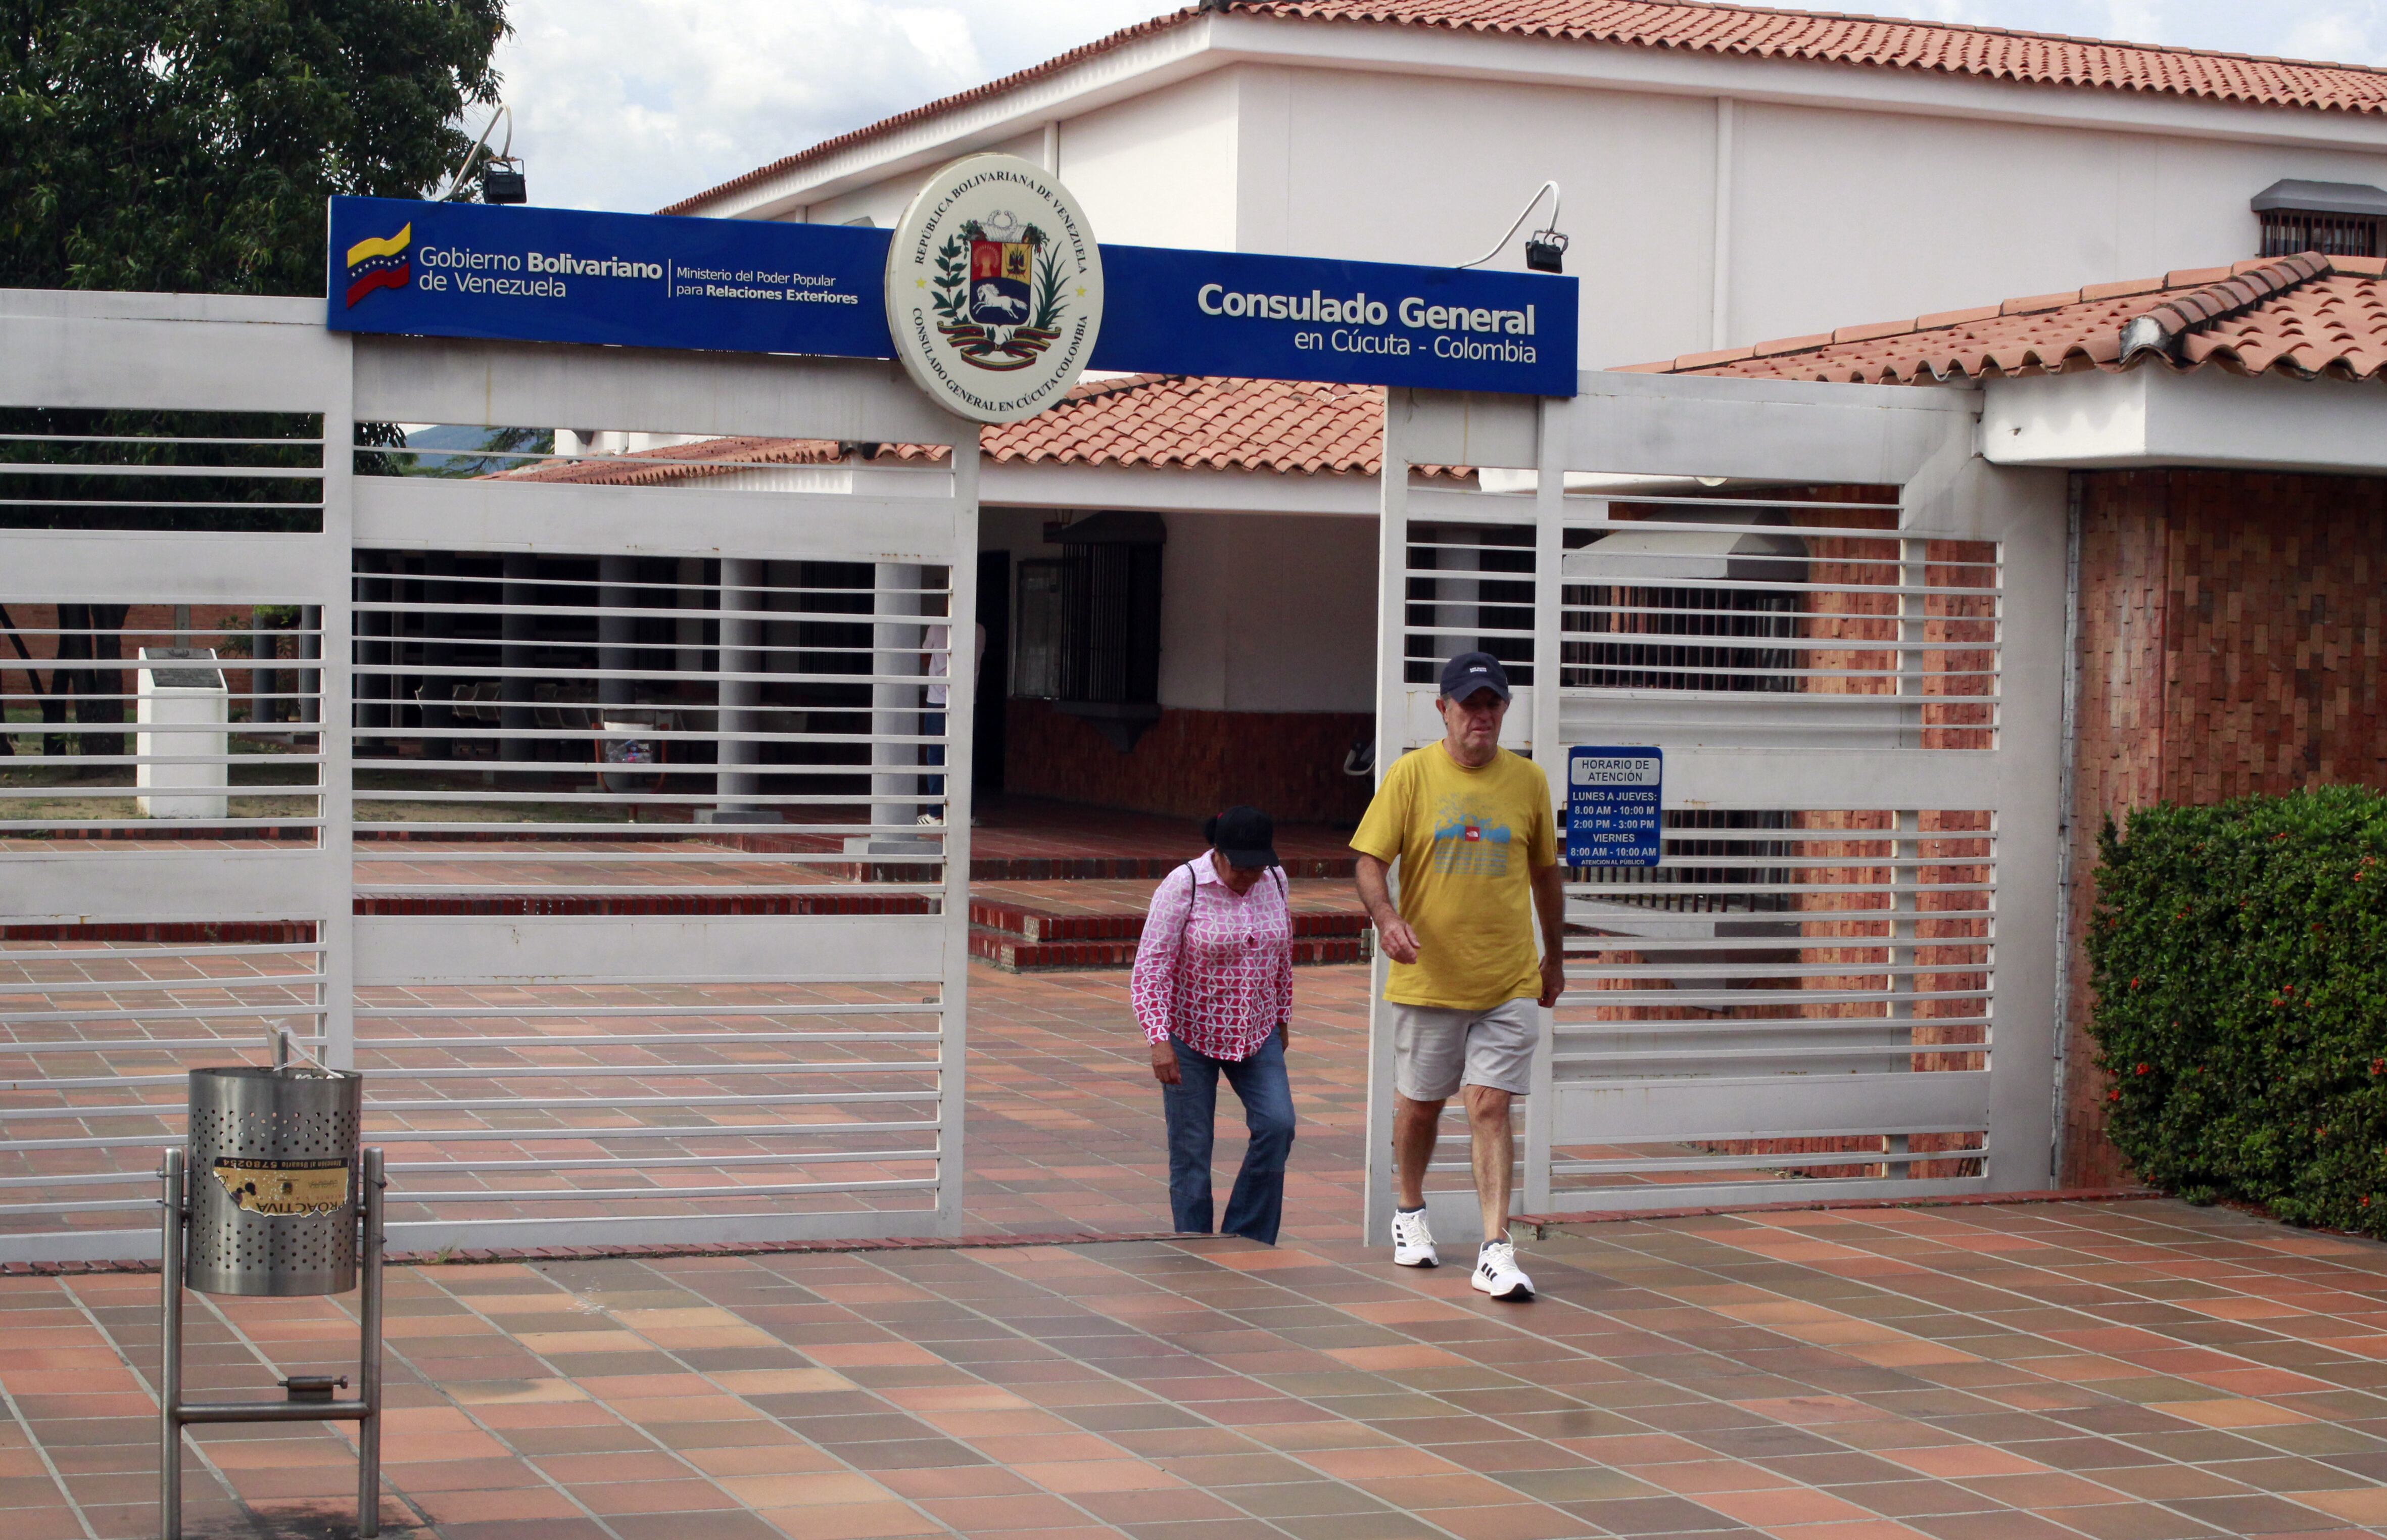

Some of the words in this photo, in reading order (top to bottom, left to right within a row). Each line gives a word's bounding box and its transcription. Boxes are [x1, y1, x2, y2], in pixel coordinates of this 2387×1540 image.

[915, 198, 953, 265] REPÚBLICA
[951, 171, 1034, 199] BOLIVARIANA
[1036, 185, 1053, 201] DE
[1053, 200, 1087, 274] VENEZUELA
[420, 246, 520, 271] Gobierno
[528, 252, 662, 279] Bolivariano
[677, 267, 732, 281] Ministerio
[736, 270, 753, 282] del
[757, 271, 790, 284] Poder
[793, 274, 836, 287] Popular
[419, 271, 447, 291] de
[455, 272, 566, 298] Venezuela
[677, 285, 703, 297] para
[706, 285, 782, 301] Relaciones
[786, 289, 858, 305] Exteriores
[1197, 283, 1388, 326] Consulado
[1399, 297, 1536, 335] General
[1294, 330, 1323, 351] en
[1331, 329, 1410, 356] Cúcuta
[1434, 335, 1537, 363] Colombia
[913, 308, 947, 380] CONSULADO
[946, 379, 996, 411] GENERAL
[999, 401, 1014, 411] EN
[1016, 378, 1059, 408] CÚCUTA
[1056, 316, 1087, 378] COLOMBIA
[1582, 760, 1632, 769] HORARIO
[1636, 760, 1649, 769] DE
[1588, 770, 1643, 782] ATENCIÓN
[1572, 792, 1605, 801] LUNES
[1607, 792, 1614, 801] A
[1616, 792, 1657, 801] JUEVES:
[1596, 806, 1611, 814] AM
[1619, 806, 1644, 815] 10:00
[1646, 806, 1654, 814] M
[1573, 820, 1593, 829] 2:00
[1596, 820, 1610, 829] PM
[1618, 820, 1638, 829] 3:00
[1640, 820, 1654, 829] PM
[1593, 834, 1635, 842] VIERNES
[1570, 847, 1590, 856] 8:00
[1592, 847, 1607, 856] AM
[1615, 847, 1639, 856] 10:00
[1641, 847, 1656, 856] AM
[223, 1159, 277, 1168] 5780254
[282, 1160, 308, 1168] Usuario
